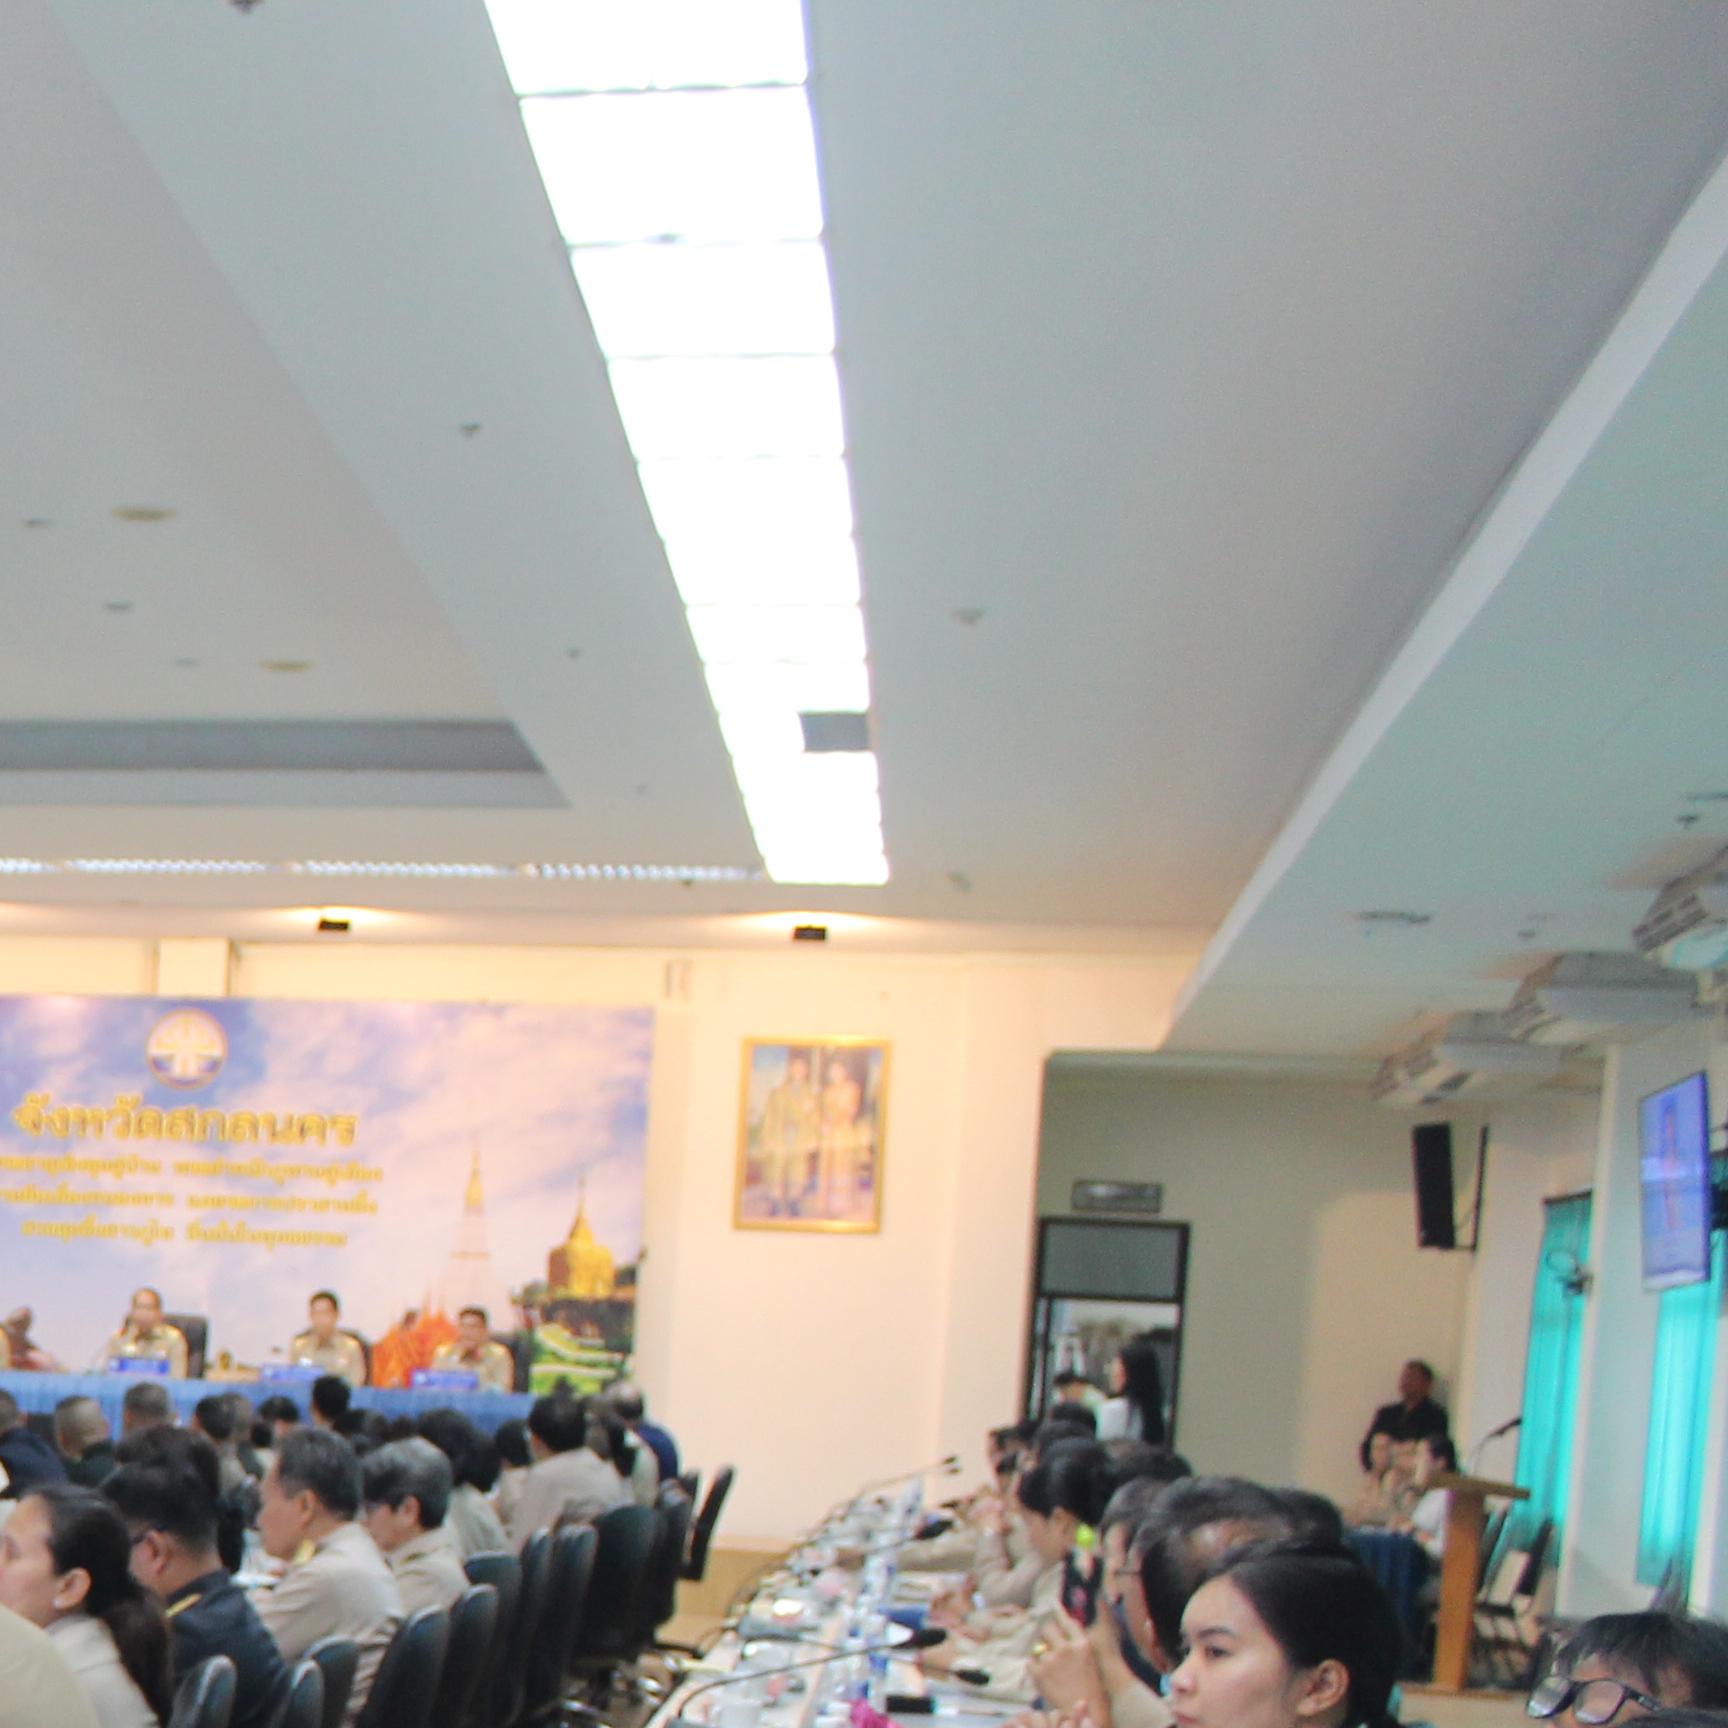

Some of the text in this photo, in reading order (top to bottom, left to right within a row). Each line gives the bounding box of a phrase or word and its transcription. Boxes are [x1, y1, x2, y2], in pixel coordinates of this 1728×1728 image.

[11, 1093, 359, 1146] จังหวัดสกลนคร
